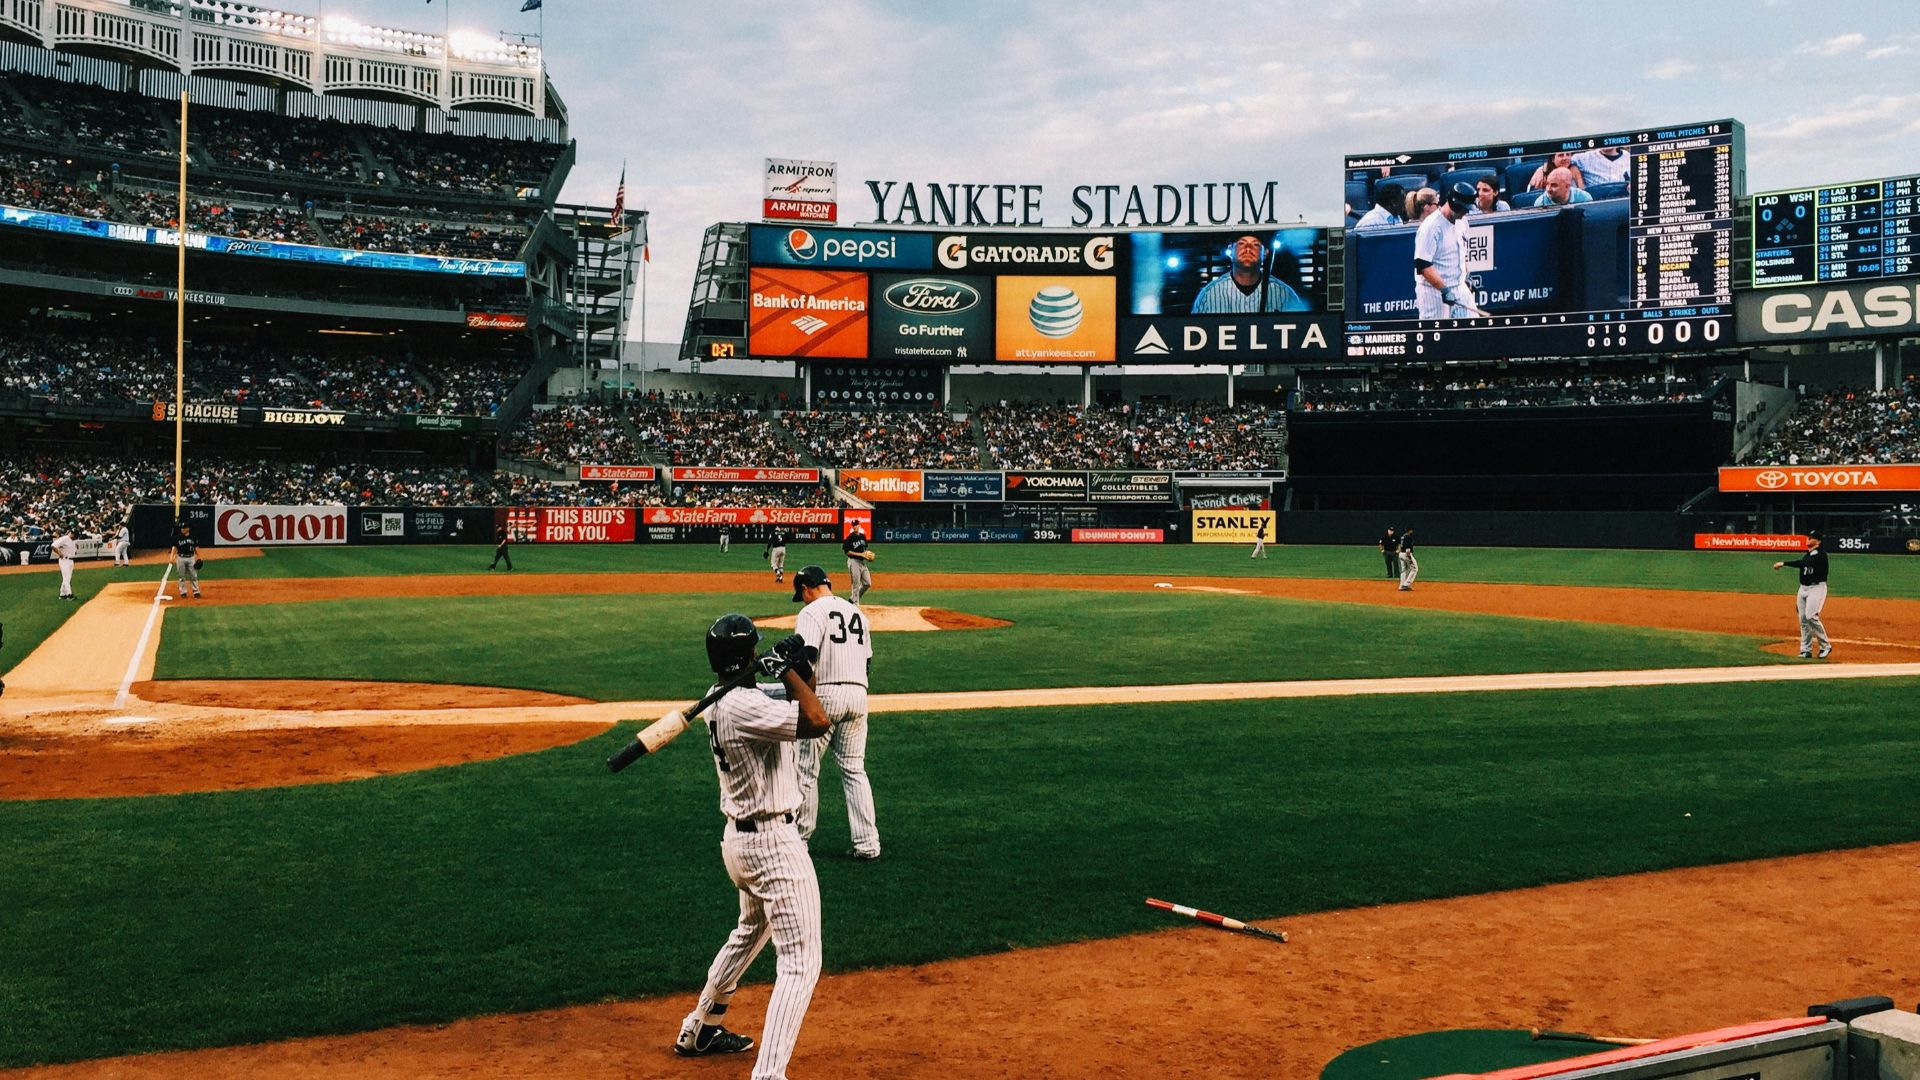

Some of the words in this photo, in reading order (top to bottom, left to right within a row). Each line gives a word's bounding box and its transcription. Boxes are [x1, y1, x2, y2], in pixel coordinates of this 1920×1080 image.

[1678, 128, 1705, 136] PITCHES
[1708, 125, 1719, 133] 18
[1604, 136, 1630, 145] STRIKES
[1638, 134, 1648, 142] 12
[1648, 143, 1675, 152] SEATTLE
[1677, 139, 1710, 149] MARINERS
[1660, 151, 1685, 159] MILLER
[1371, 158, 1395, 166] America
[1660, 158, 1686, 166] SEAGER
[768, 165, 833, 178] ARMITRON
[1897, 180, 1911, 188] MIA
[1660, 186, 1690, 194] JACKSON
[1660, 193, 1686, 201] ACKLEY
[1759, 197, 1778, 206] LAD
[1789, 193, 1812, 202] WSH
[771, 202, 830, 213] ARMITRON
[864, 180, 1043, 228] YANKEE
[1071, 181, 1278, 227] STADIUM
[1660, 199, 1696, 208] MORRISON
[1660, 214, 1705, 223] MONTGOMERY
[1762, 209, 1772, 221] 0
[1795, 206, 1805, 218] 0
[108, 224, 147, 241] BRIAN
[1664, 225, 1680, 233] YORK
[1683, 223, 1711, 232] YANKEES
[1660, 234, 1695, 242] ELLSBURY
[823, 237, 896, 262] pepsi
[1660, 241, 1691, 249] GARDNER
[938, 236, 967, 270] G
[971, 247, 1081, 263] GATORADE
[1084, 237, 1114, 270] G
[1660, 248, 1698, 256] RODRIGUEZ
[1756, 249, 1791, 258] STARTERS:
[1660, 255, 1691, 263] TEIXEIRA
[1756, 258, 1794, 267] BOLSINGER
[437, 258, 458, 270] New
[458, 261, 480, 274] York
[482, 262, 519, 275] Yankees
[1660, 262, 1689, 270] MCCANN
[1858, 264, 1879, 272] 10:05
[1756, 275, 1802, 284] ZIMMERMANN
[1660, 283, 1698, 291] GREGORIUS
[136, 289, 164, 298] Audi
[168, 291, 203, 302] YAKEES
[206, 296, 225, 304] CLUB
[903, 284, 960, 308] Ford
[1491, 291, 1510, 302] CAP
[1513, 289, 1525, 300] OF
[753, 293, 789, 308] Bank
[791, 295, 806, 308] of
[806, 296, 865, 311] America
[1364, 303, 1381, 314] THE
[1385, 300, 1418, 312] OFFICIA
[1660, 299, 1687, 307] TANAKA
[1669, 308, 1696, 316] STRIKES
[467, 316, 526, 327] Budweiser
[899, 325, 917, 335] Go
[920, 325, 964, 336] Further
[1648, 323, 1664, 344] 0
[1675, 321, 1691, 342] 0
[1704, 320, 1720, 341] 0
[1183, 323, 1328, 351] DELTA
[1365, 334, 1406, 344] MARINERS
[712, 344, 733, 357] 0:27
[895, 347, 951, 355] tristateford.com
[1015, 348, 1095, 359] att.yankees.com
[1365, 346, 1405, 355] YANKEES
[264, 411, 345, 425] BIGELOW.
[416, 416, 438, 425] Poland
[440, 417, 461, 427] Spring
[1025, 477, 1084, 486] YOKOHAMA
[1092, 473, 1125, 486] Yankees
[1792, 472, 1878, 486] TOYOTA
[860, 477, 920, 494] DraftKings
[1191, 497, 1226, 509] Peanut
[1229, 493, 1262, 505] Chews
[546, 510, 579, 524] THIS
[582, 510, 625, 524] BUD'S
[1197, 517, 1270, 528] STANLEY
[217, 509, 345, 541] Canon
[546, 526, 574, 540] FOR
[578, 526, 609, 540] YOU.
[34, 545, 49, 555] ACC
[829, 611, 864, 645] 34
